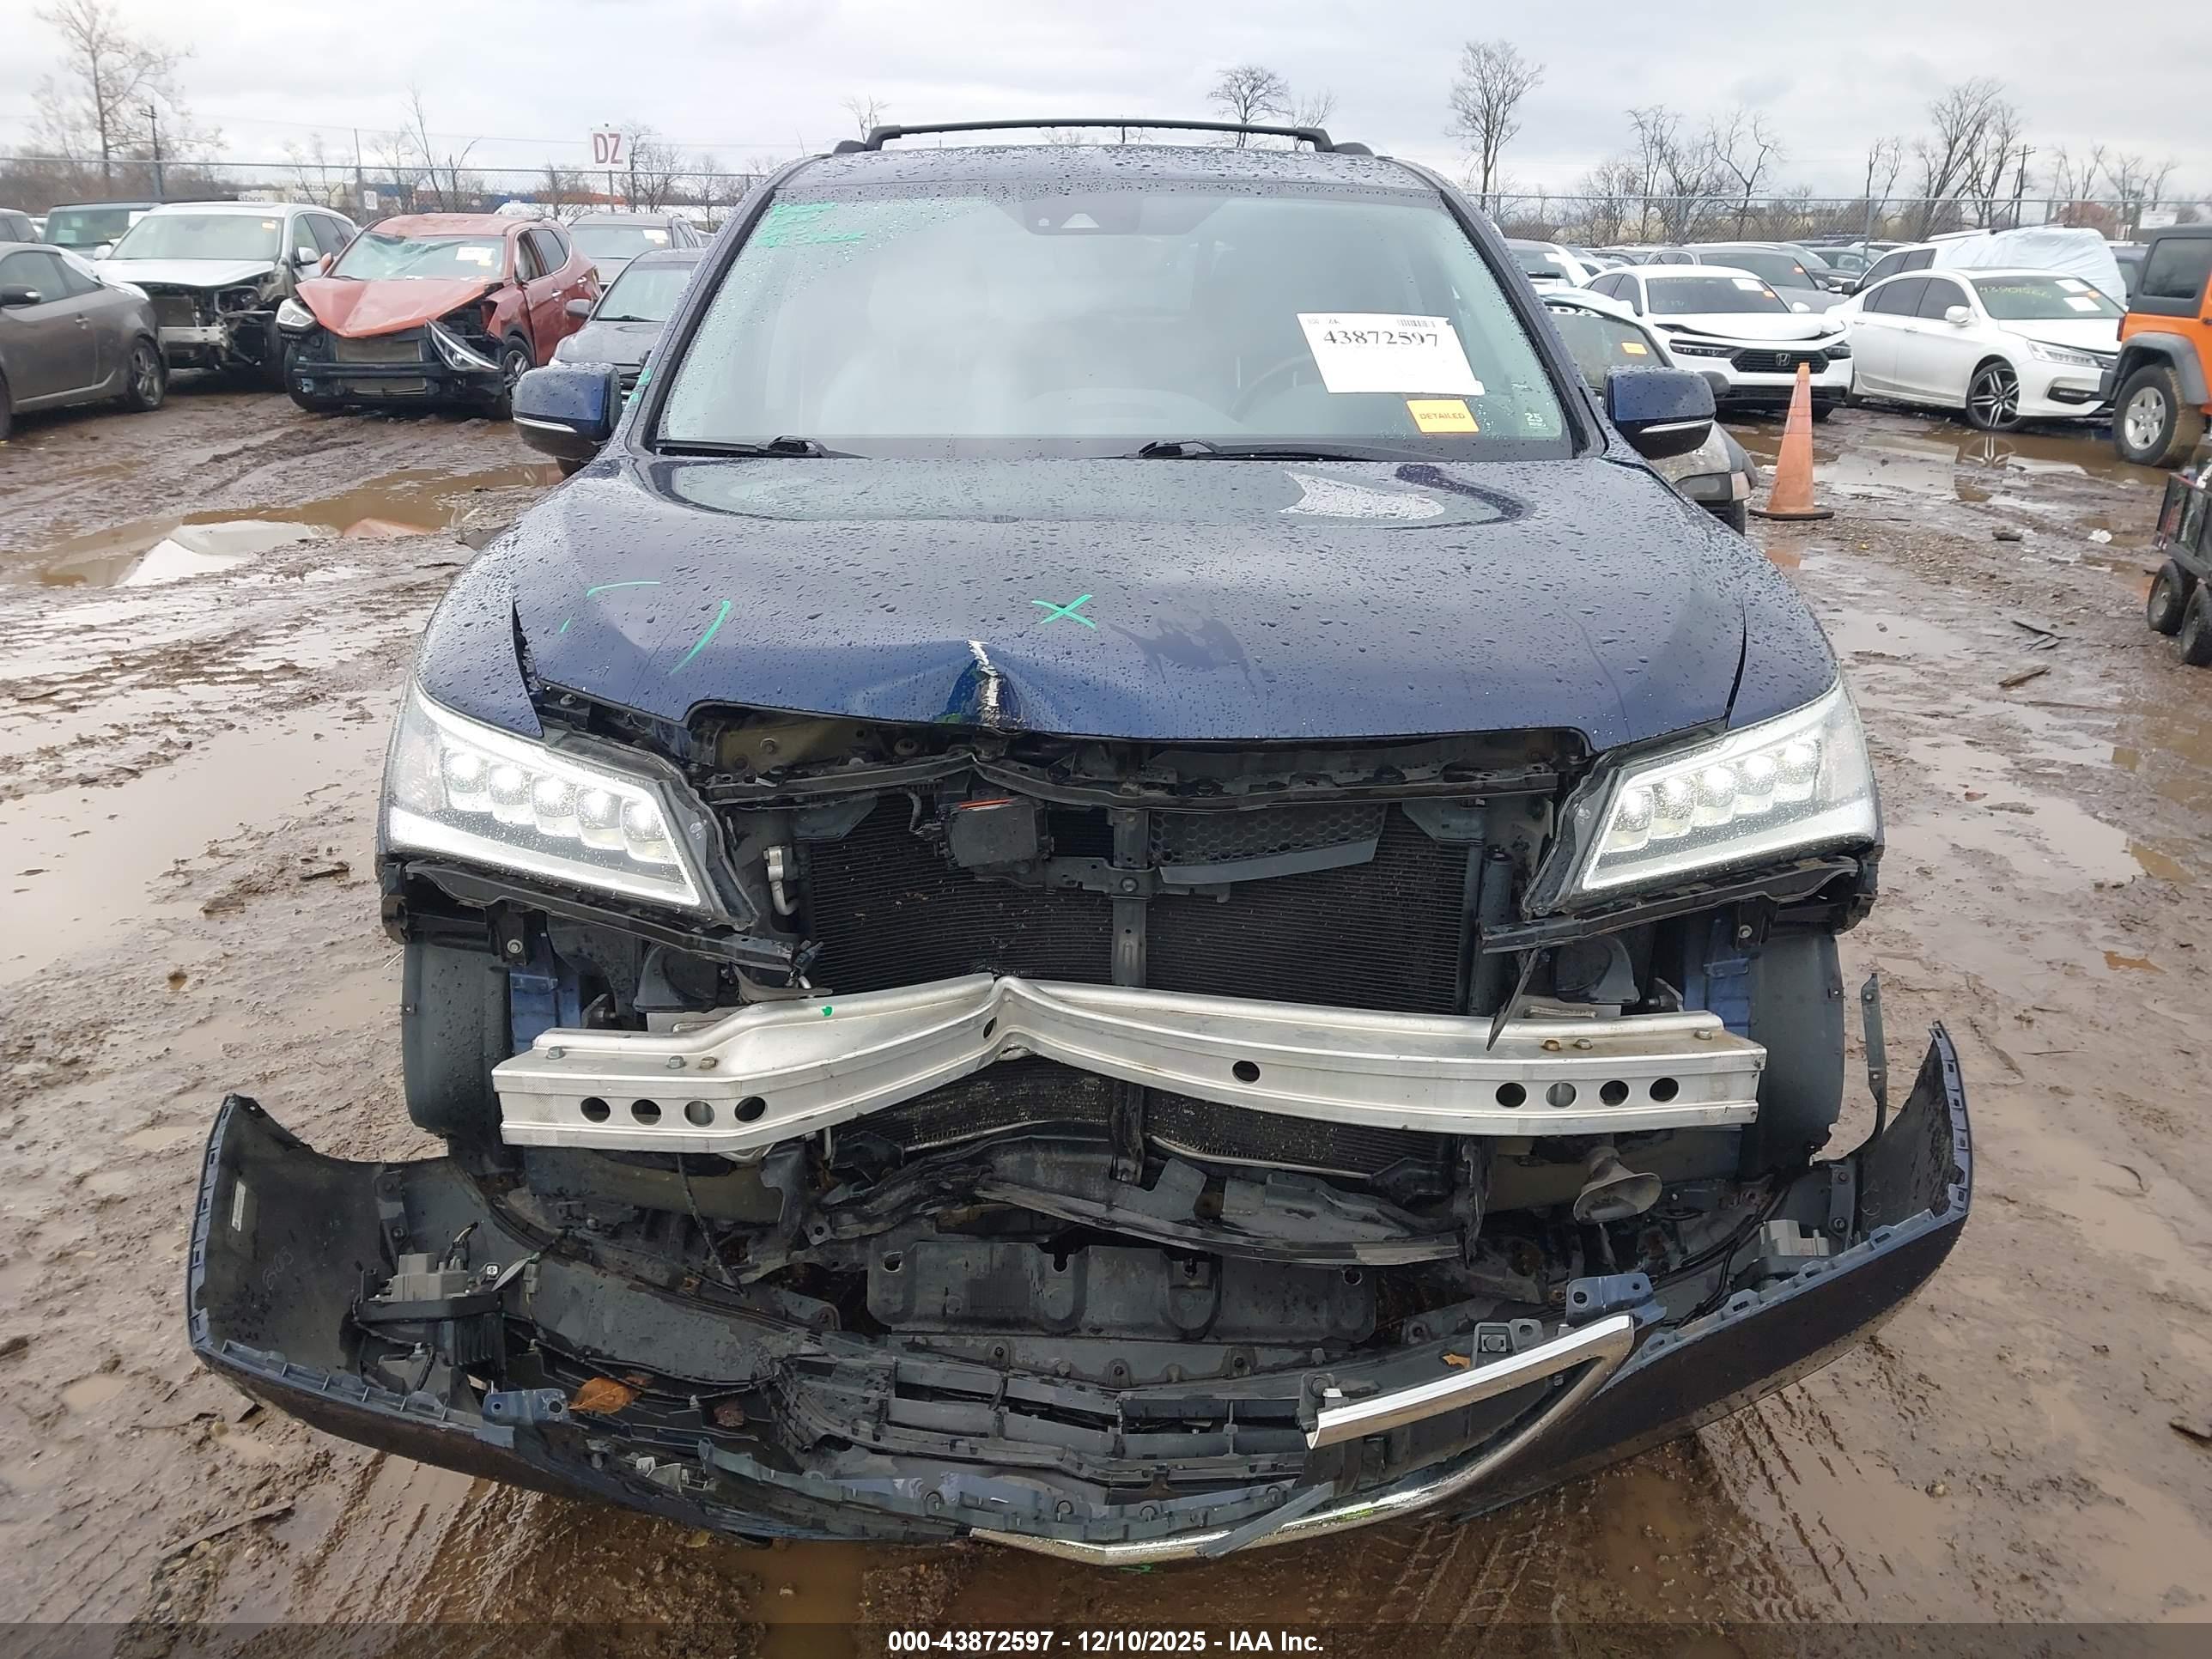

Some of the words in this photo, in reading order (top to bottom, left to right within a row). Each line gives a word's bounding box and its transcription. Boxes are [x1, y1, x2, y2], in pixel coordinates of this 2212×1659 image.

[592, 132, 623, 164] DZ
[239, 194, 265, 203] atson
[1323, 330, 1438, 347] 43872597
[1524, 412, 1543, 422] 25
